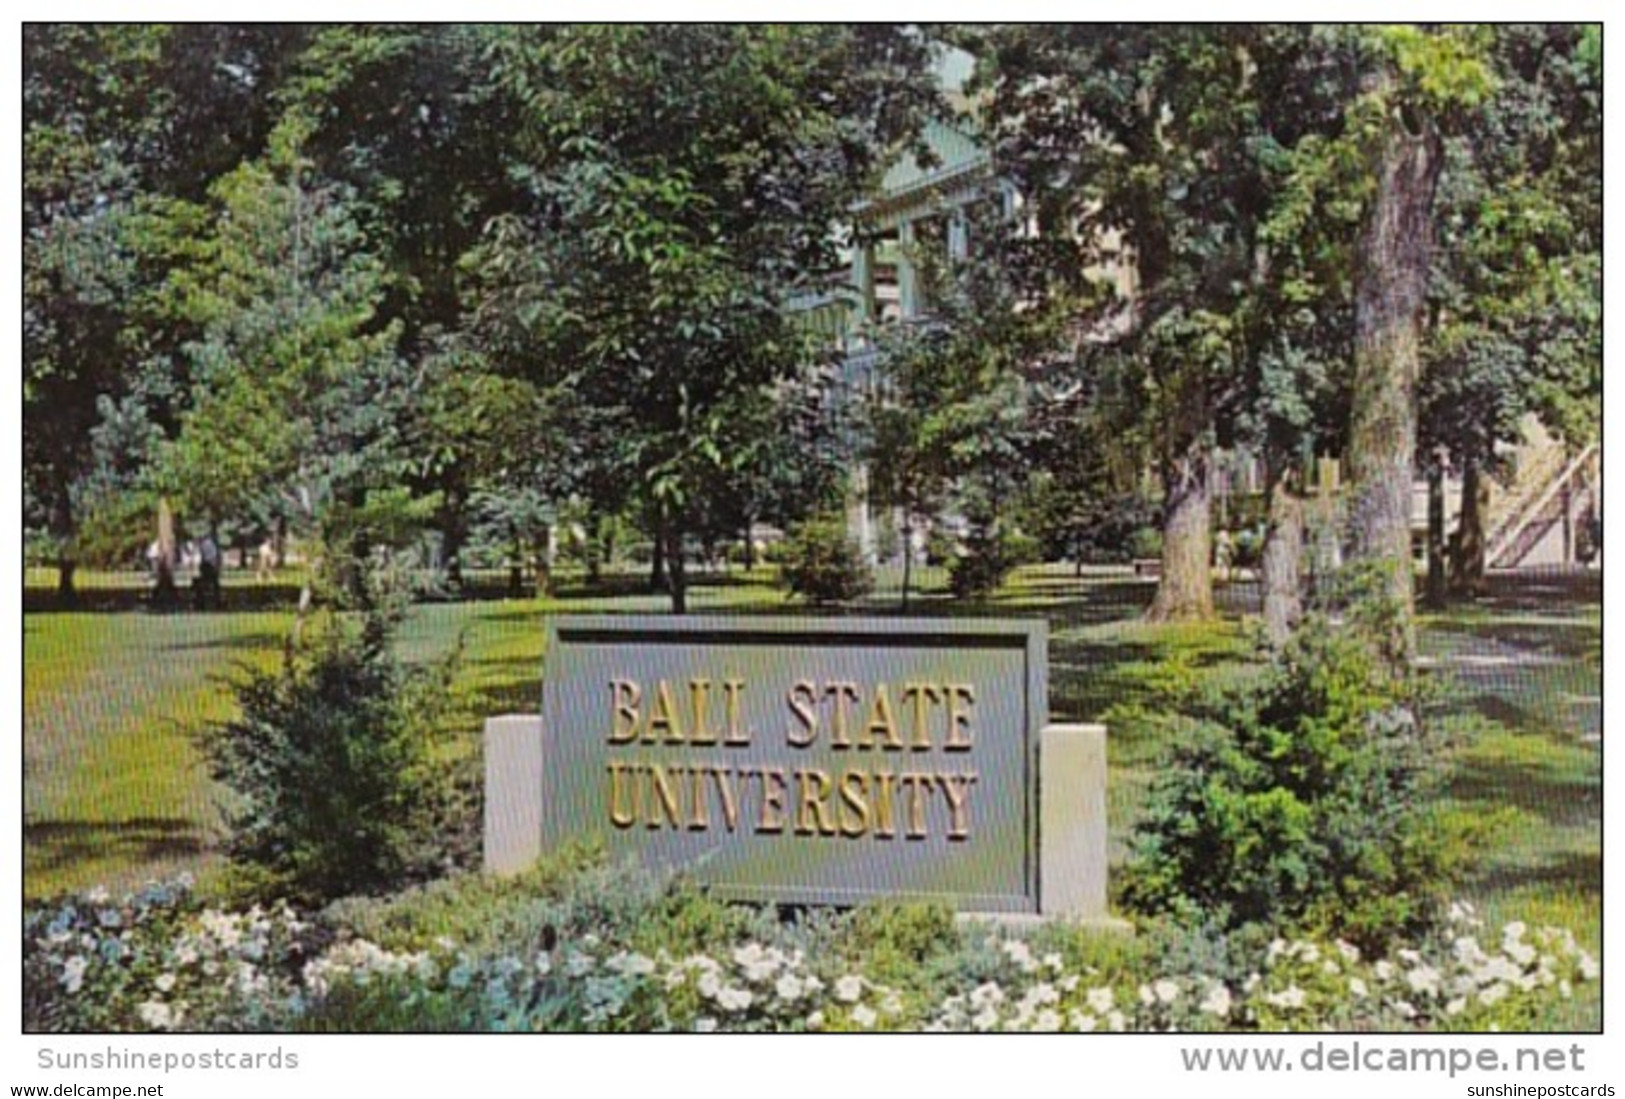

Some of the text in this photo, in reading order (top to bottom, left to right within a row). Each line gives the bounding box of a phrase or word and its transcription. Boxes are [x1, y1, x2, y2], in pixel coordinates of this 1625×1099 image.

[607, 677, 977, 753] BALL STATE
[606, 763, 978, 841] UNIVERSITY
